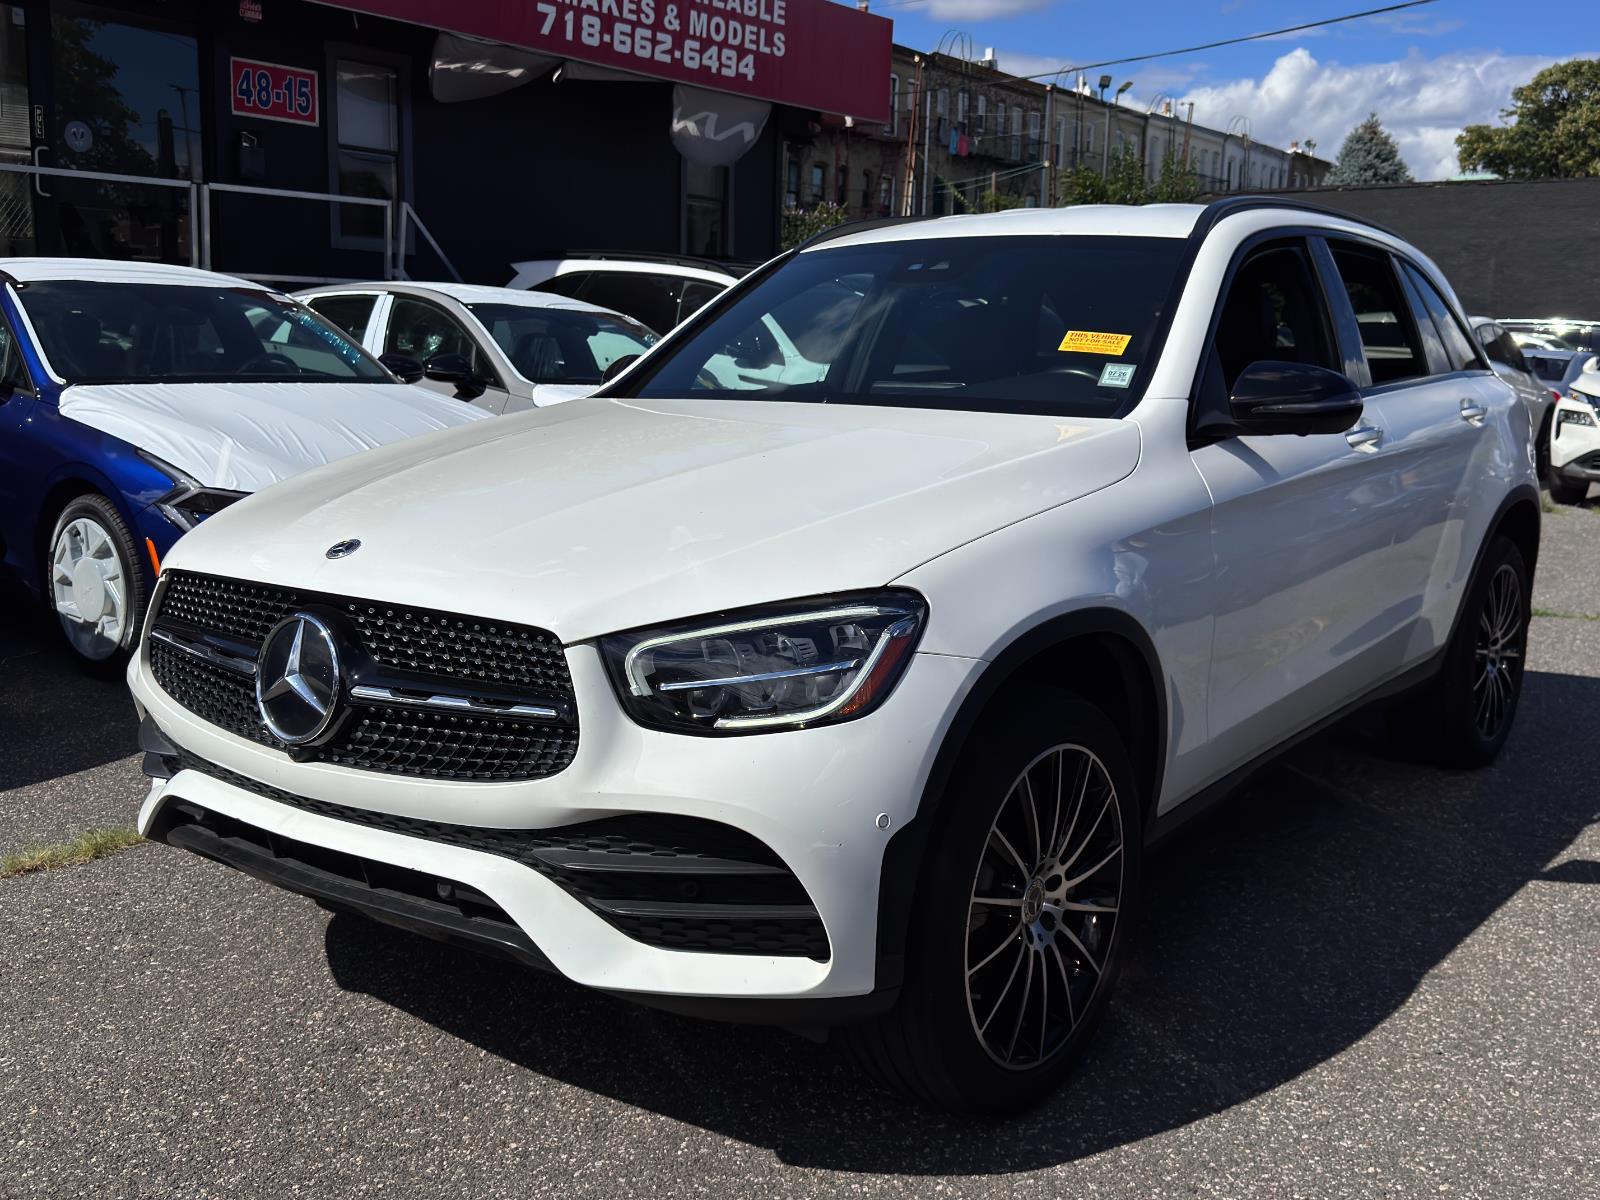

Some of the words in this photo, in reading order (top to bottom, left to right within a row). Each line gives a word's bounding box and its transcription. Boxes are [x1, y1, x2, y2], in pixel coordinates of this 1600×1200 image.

[537, 2, 755, 81] 718-662-6494
[557, 0, 656, 25] KES
[663, 4, 681, 31] &
[689, 9, 786, 57] MODELS
[236, 68, 312, 116] 48-15
